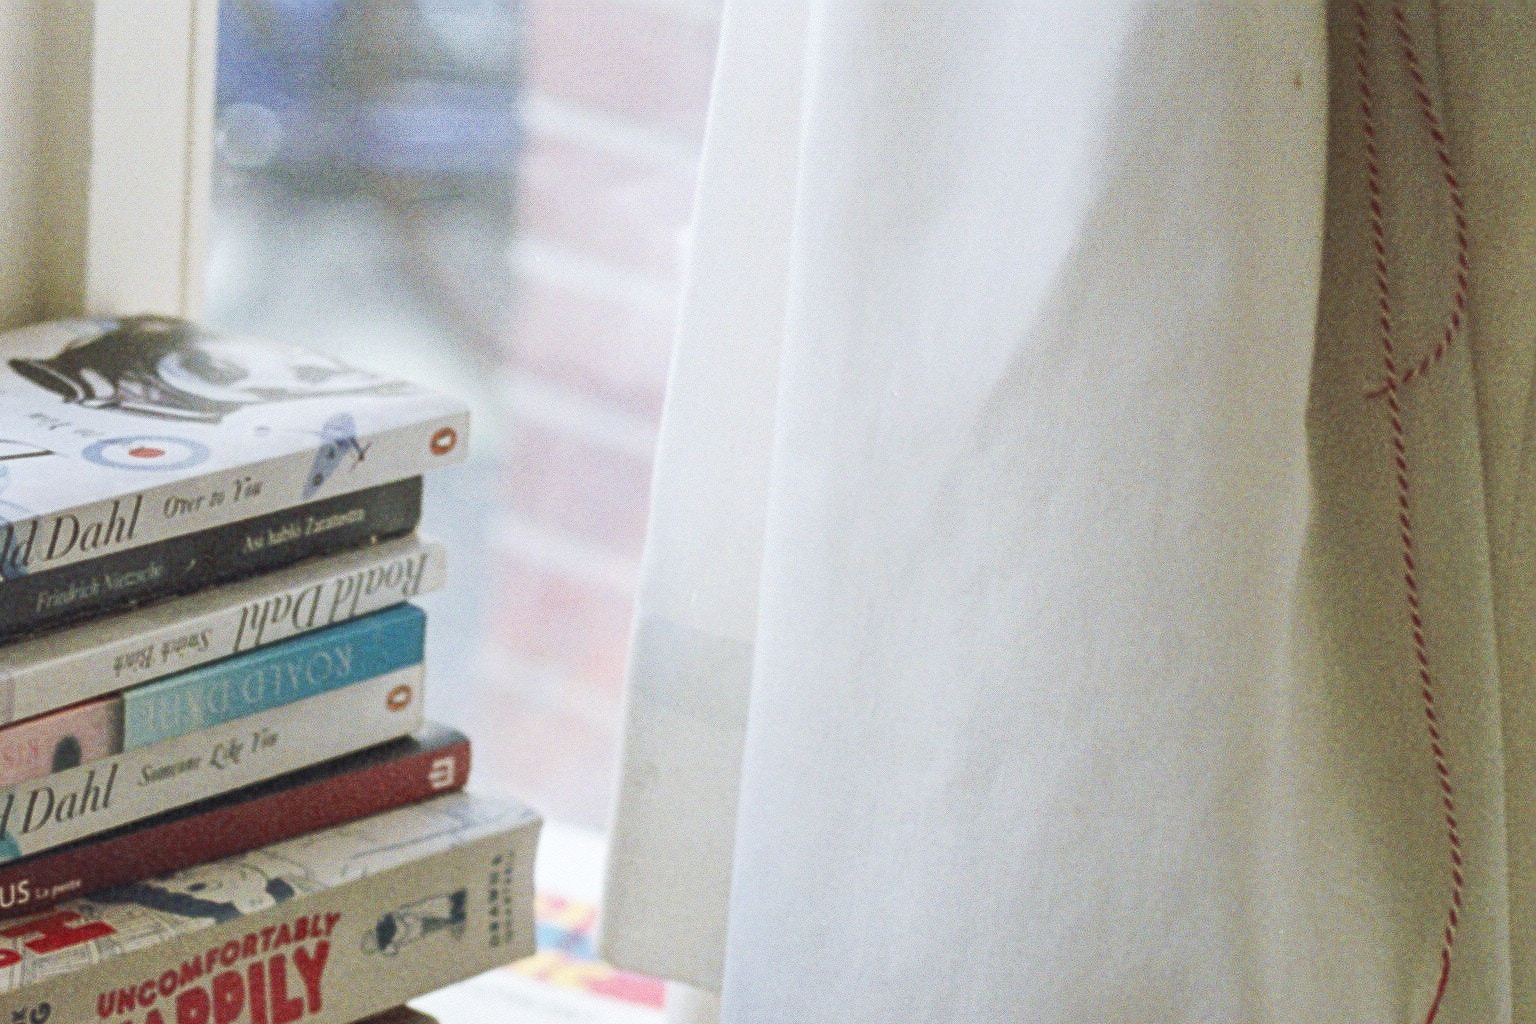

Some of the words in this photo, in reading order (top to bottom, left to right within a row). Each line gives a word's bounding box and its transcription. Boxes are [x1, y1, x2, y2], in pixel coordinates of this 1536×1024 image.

[45, 495, 143, 560] Dahl
[164, 495, 204, 518] Over
[209, 490, 225, 506] to
[232, 476, 262, 502] You
[233, 586, 324, 652] Dahl
[329, 552, 428, 624] Roald
[244, 645, 356, 699] ROALD
[21, 762, 120, 834] Dahl
[96, 912, 342, 1020] UNCOMFORTABLY
